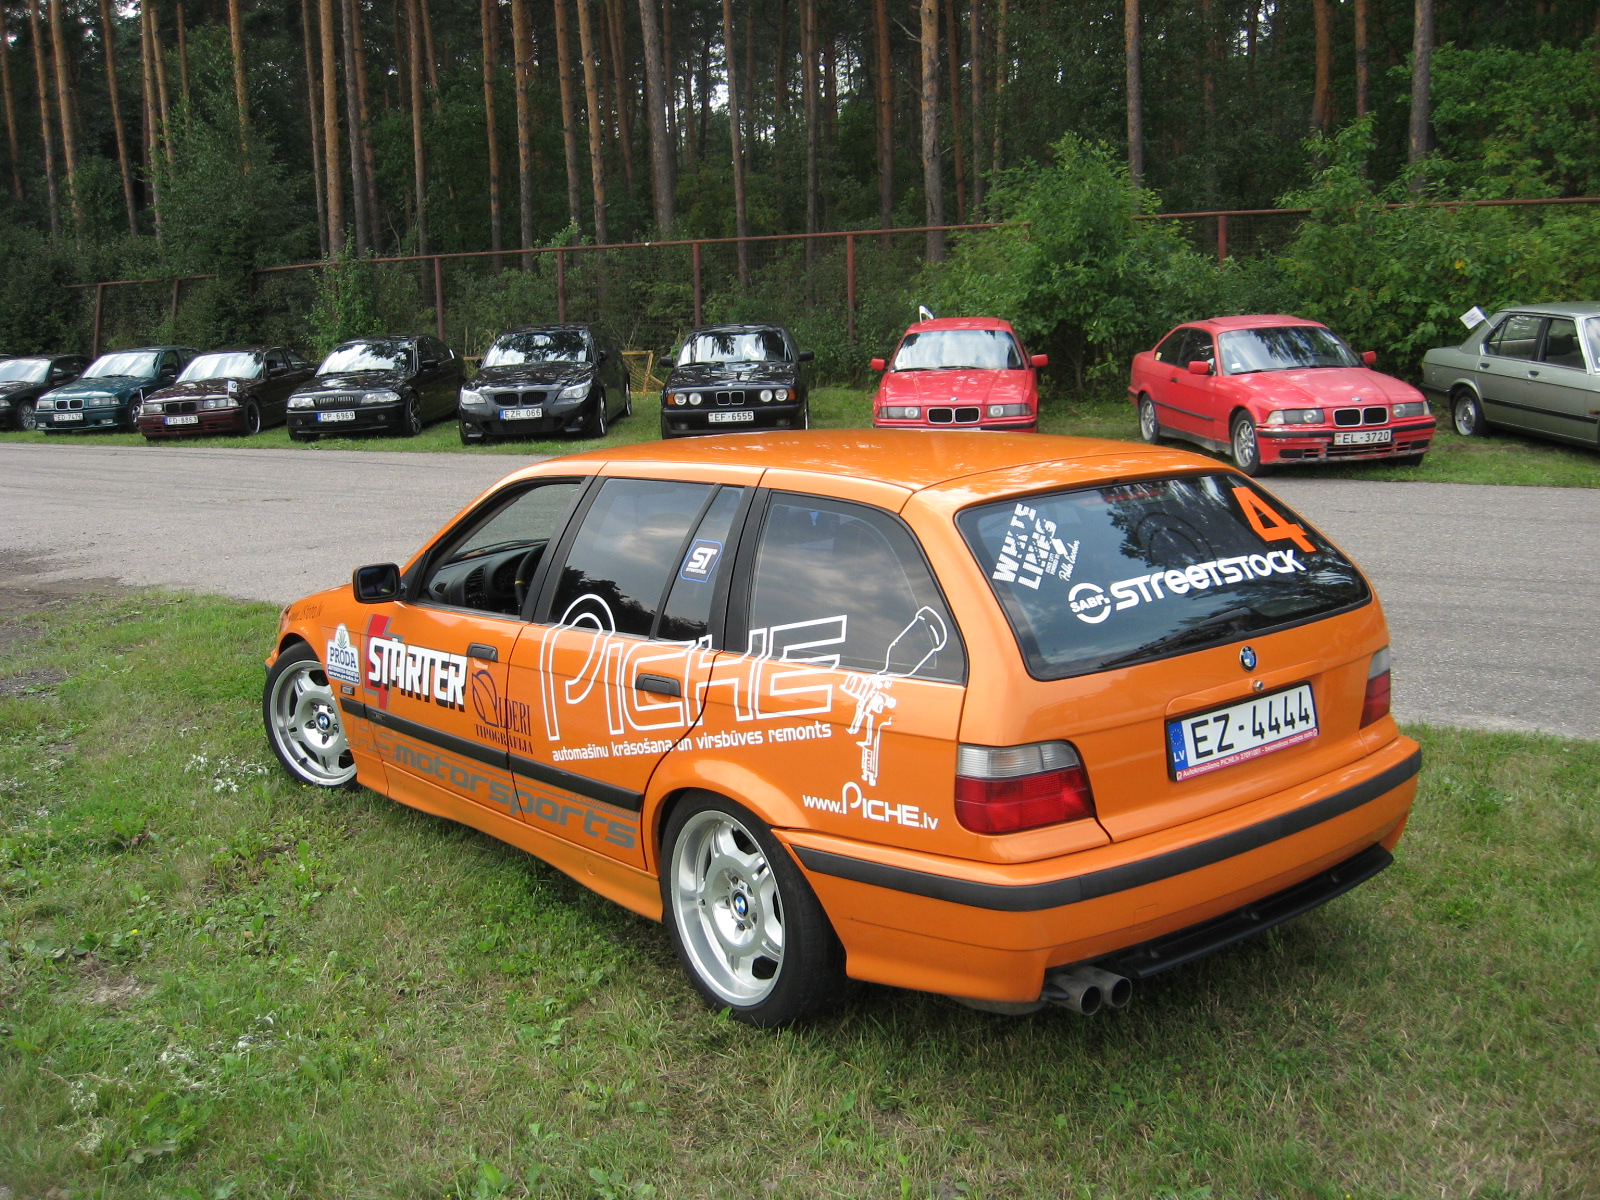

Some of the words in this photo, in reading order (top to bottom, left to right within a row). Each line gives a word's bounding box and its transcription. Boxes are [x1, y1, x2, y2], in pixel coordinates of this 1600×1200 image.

[322, 411, 354, 420] CP-6969
[714, 412, 753, 422] EF-6555
[1342, 431, 1389, 444] EL-3720
[1231, 486, 1317, 553] 4
[329, 647, 357, 668] PRODA
[368, 636, 467, 711] STARTER
[539, 594, 848, 740] PICHE
[611, 738, 674, 757] krāsošana
[676, 737, 693, 751] un
[696, 730, 763, 749] virsbūves
[768, 720, 832, 743] remonts
[1173, 750, 1186, 762] LV
[1191, 691, 1310, 759] EZ-4444
